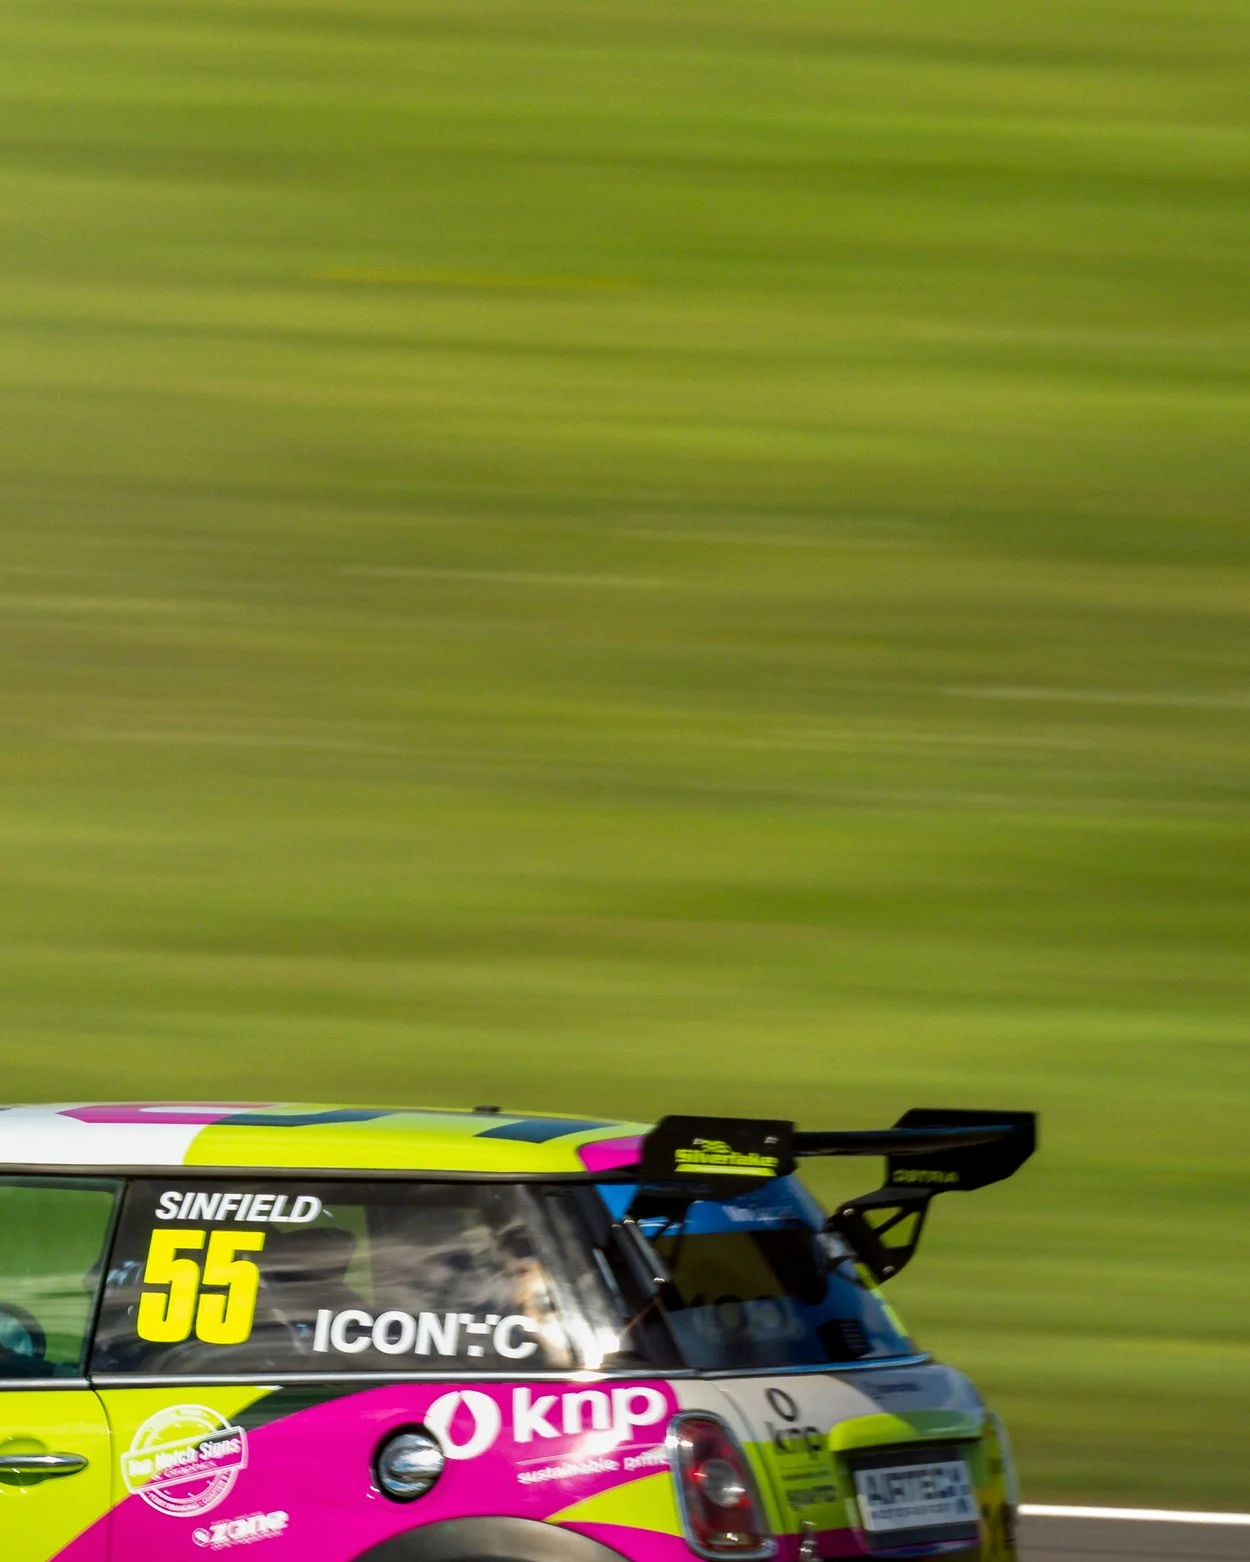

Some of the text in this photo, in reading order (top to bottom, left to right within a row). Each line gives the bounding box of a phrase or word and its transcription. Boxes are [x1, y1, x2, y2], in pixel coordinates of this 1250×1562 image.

[155, 1190, 323, 1223] SINFIELD
[137, 1229, 266, 1345] 55
[513, 1387, 667, 1443] knp
